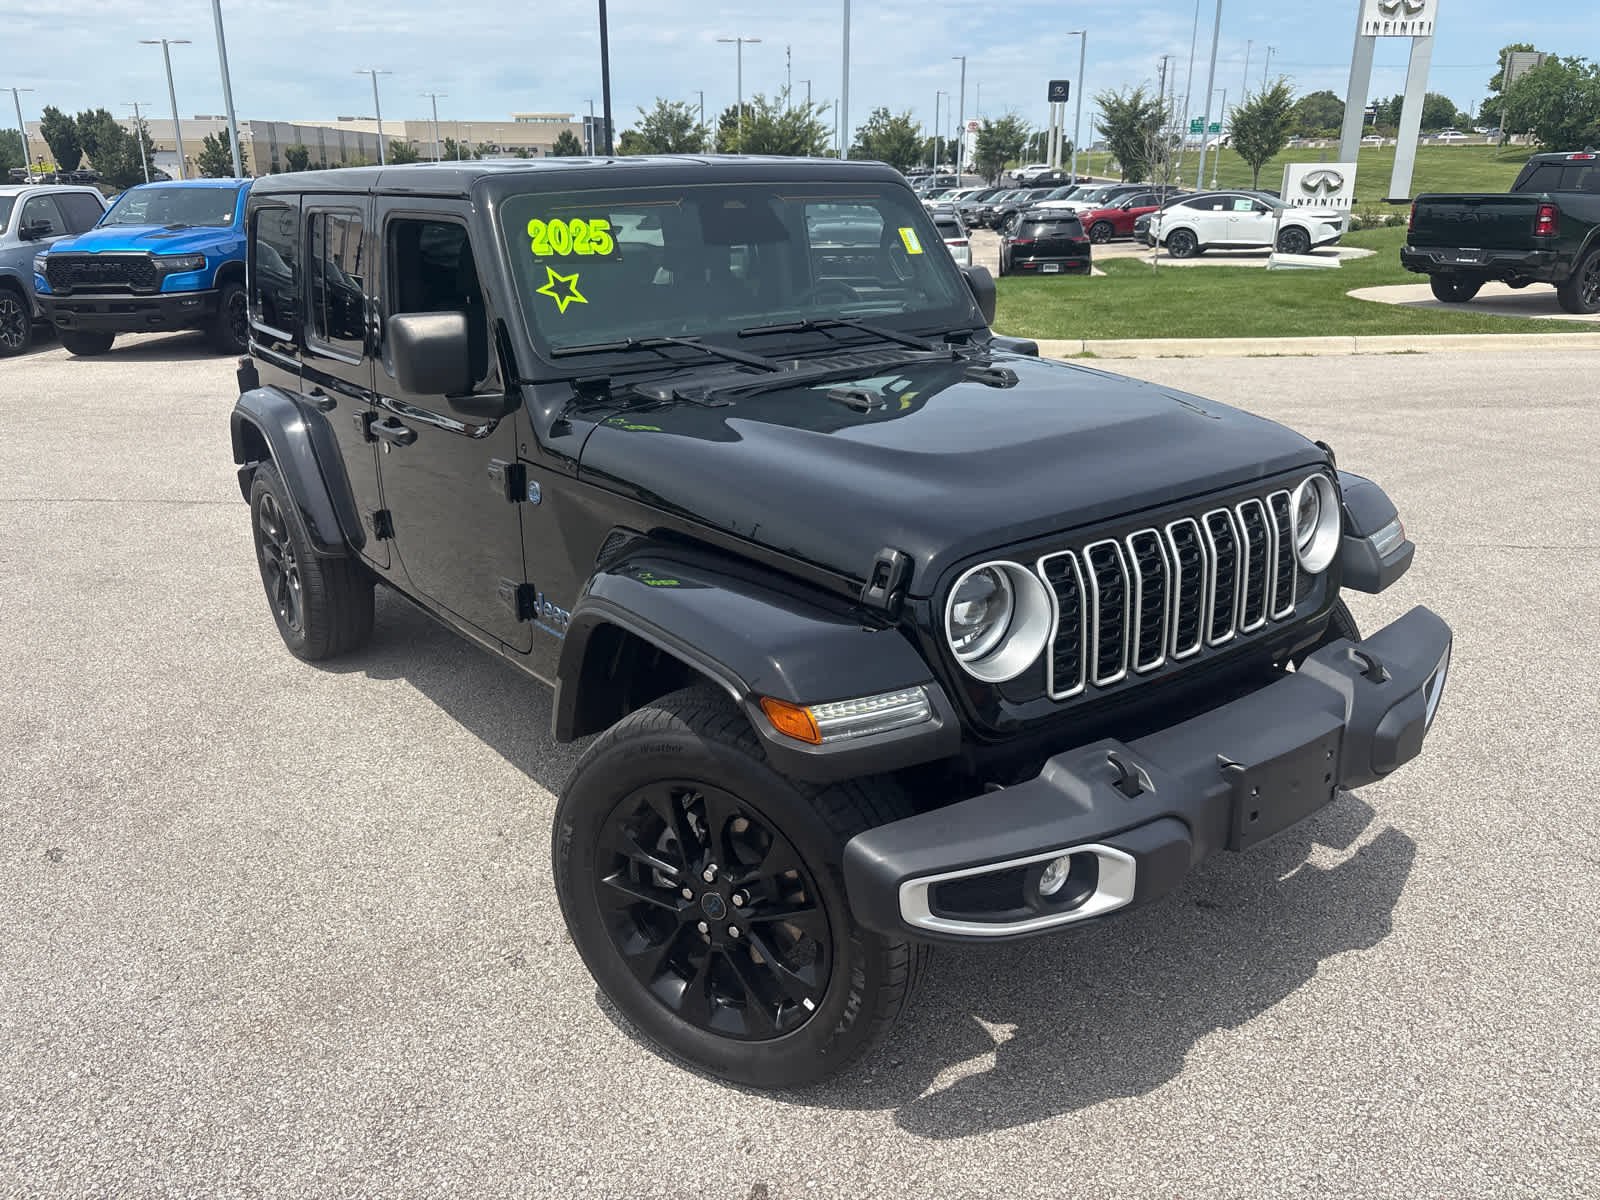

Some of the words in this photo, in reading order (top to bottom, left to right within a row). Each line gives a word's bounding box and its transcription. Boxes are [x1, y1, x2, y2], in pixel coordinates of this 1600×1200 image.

[1366, 21, 1432, 34] INFINITI
[1290, 198, 1348, 207] INFINITI
[527, 218, 614, 256] 2025
[533, 591, 571, 630] Jeep
